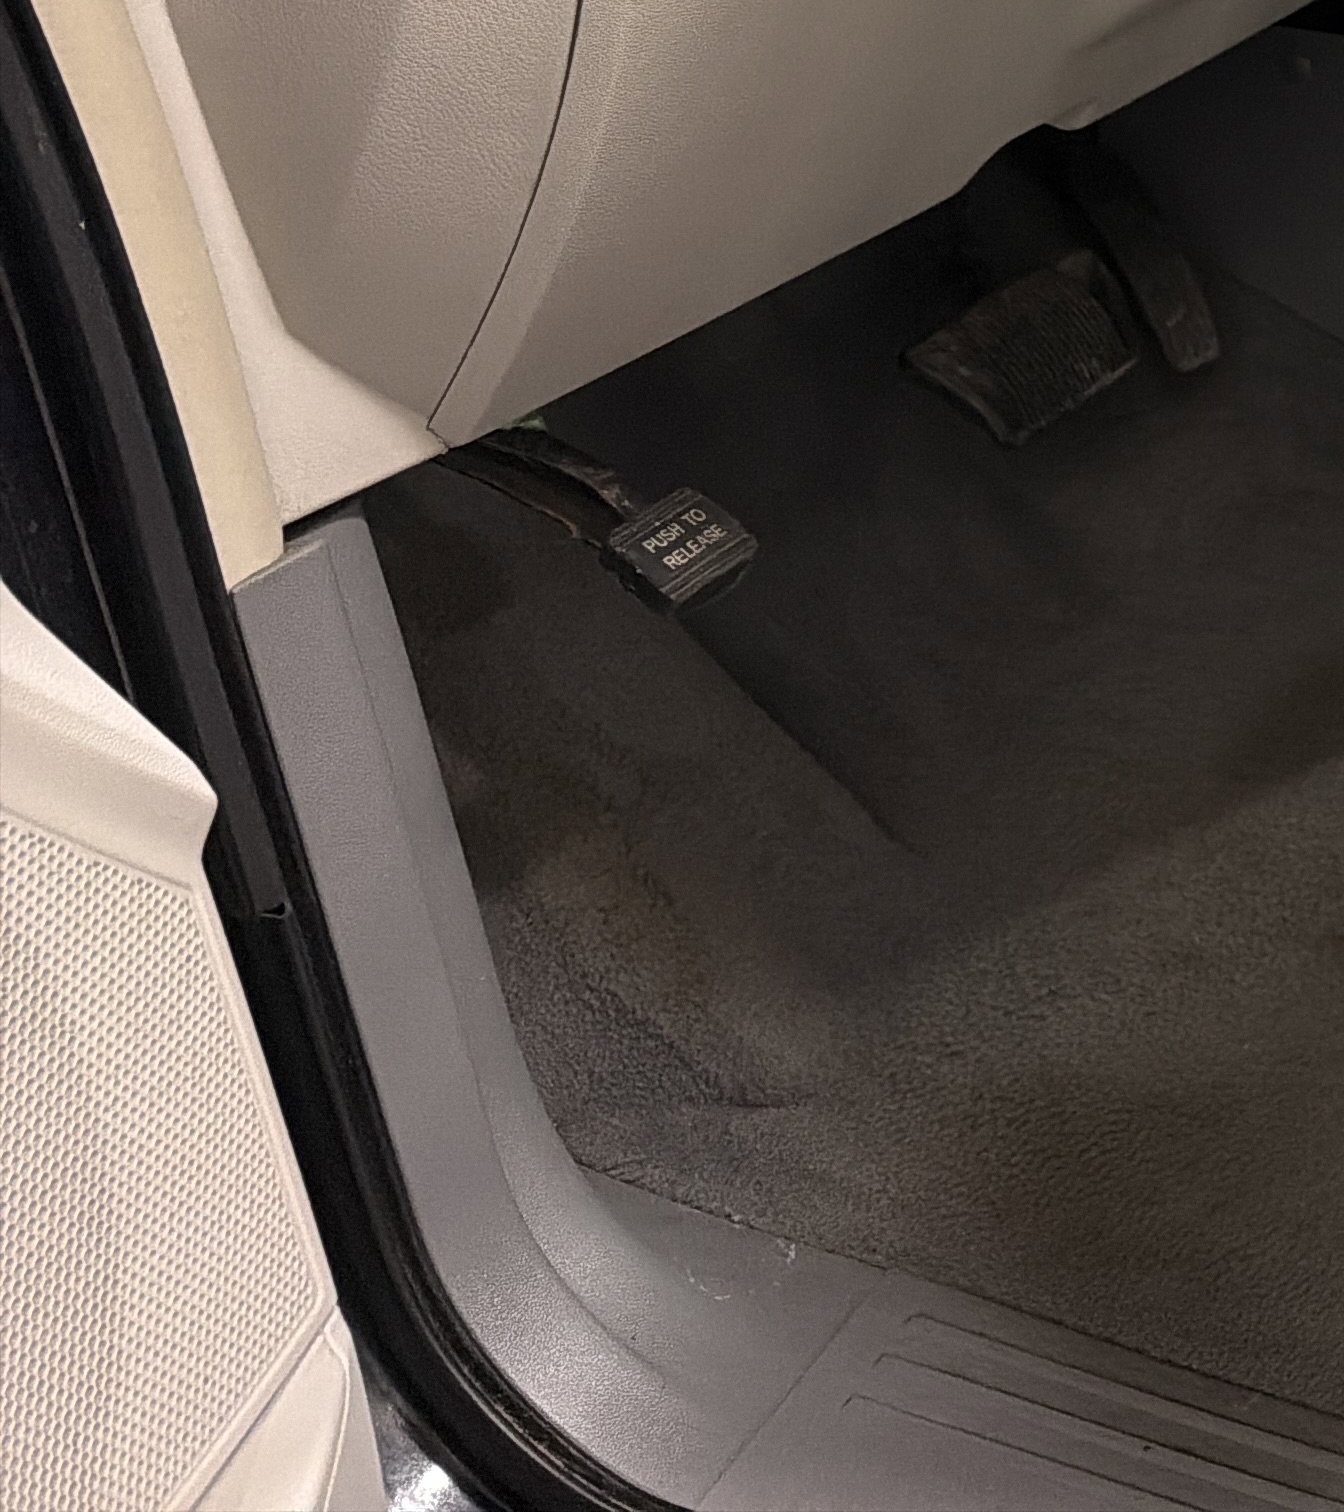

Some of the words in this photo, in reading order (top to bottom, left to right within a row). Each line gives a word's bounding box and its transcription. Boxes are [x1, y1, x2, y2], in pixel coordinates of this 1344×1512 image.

[641, 522, 686, 554] PUSH
[680, 508, 707, 526] TO
[662, 523, 728, 570] RELEASE
